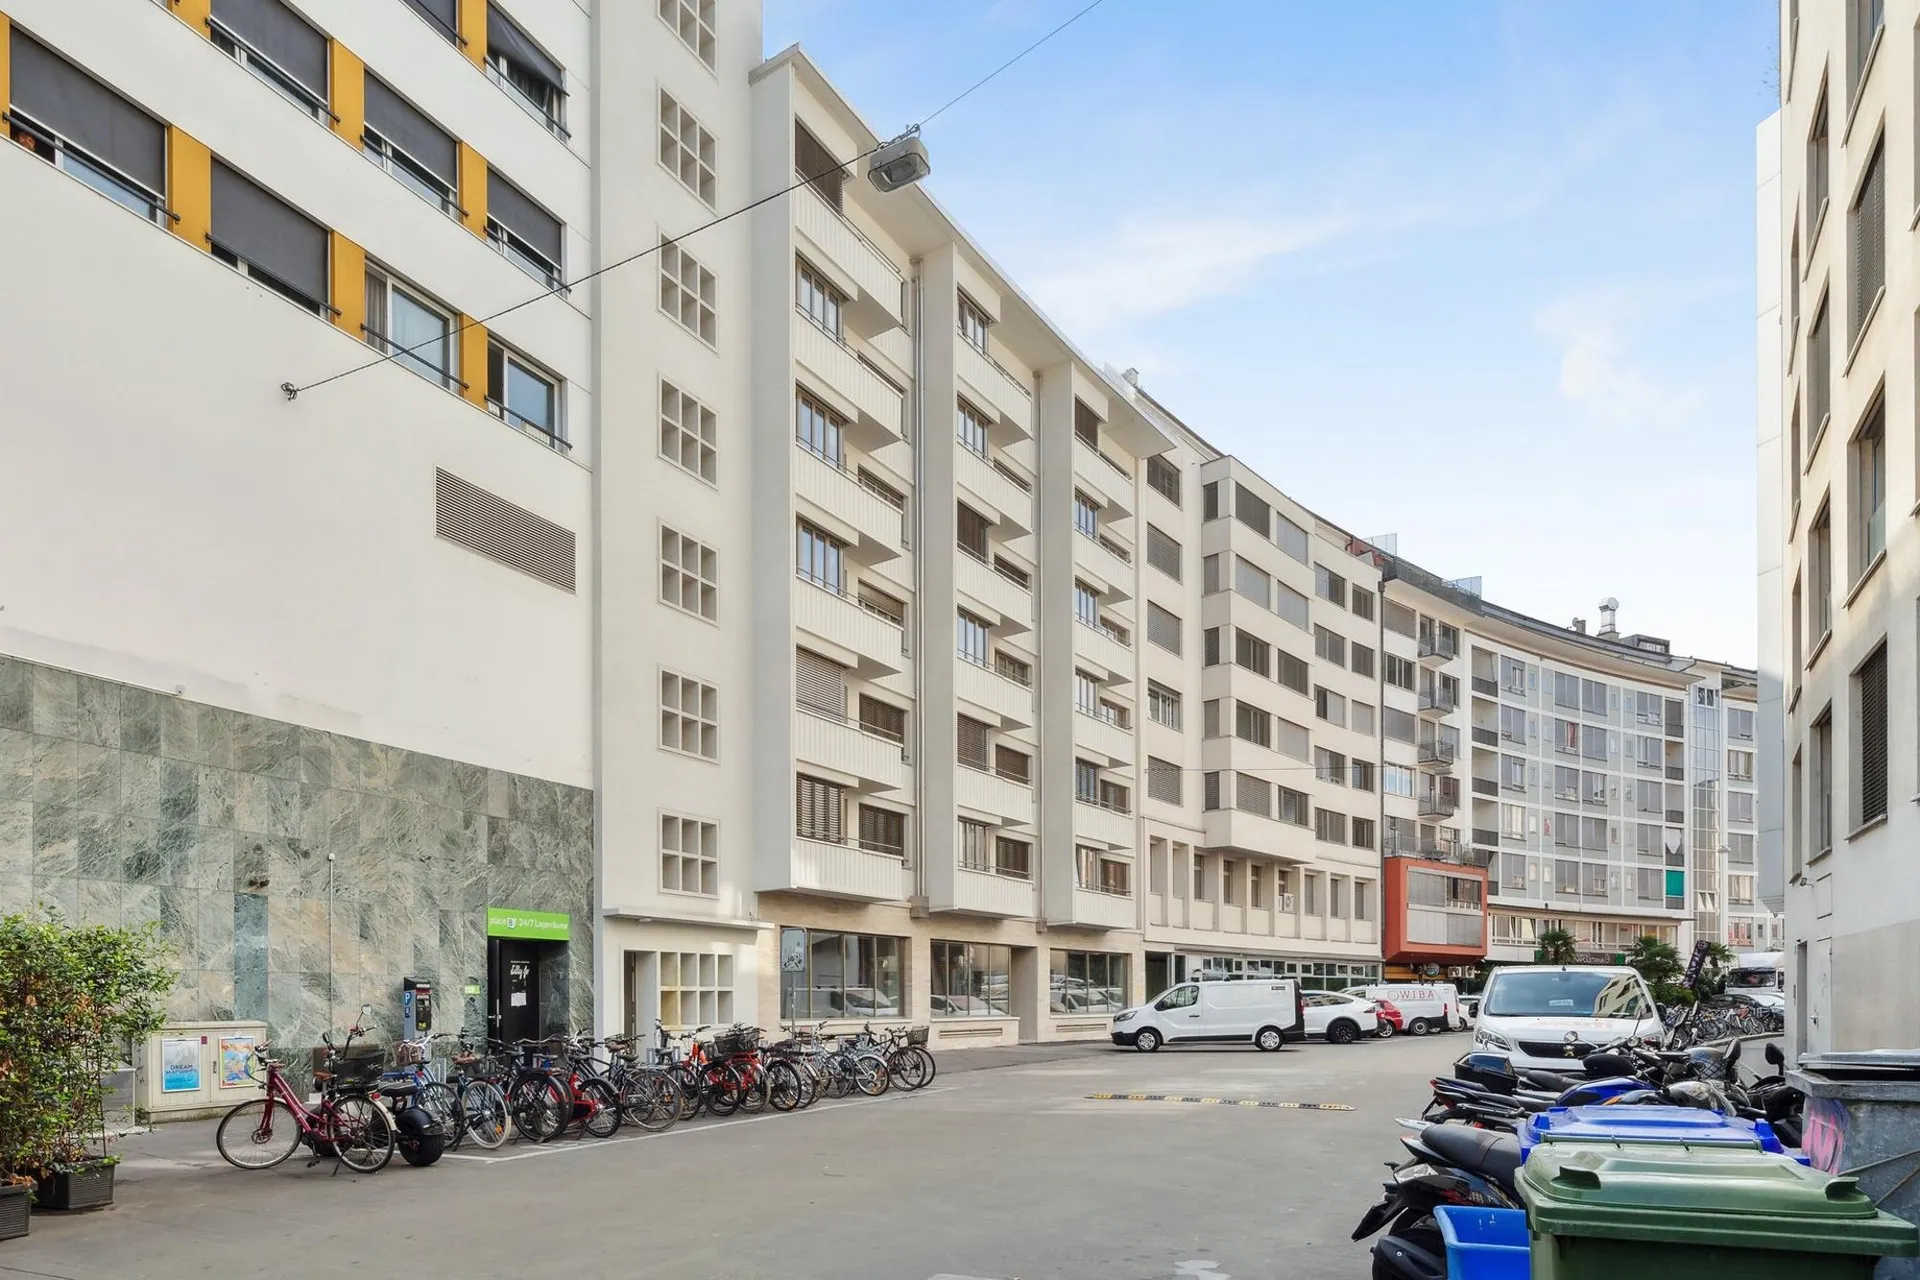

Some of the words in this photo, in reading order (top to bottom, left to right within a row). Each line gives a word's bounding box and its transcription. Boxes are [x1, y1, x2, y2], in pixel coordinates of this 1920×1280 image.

[519, 917, 535, 928] 24/7
[404, 992, 411, 1004] P
[1400, 990, 1434, 999] WIBA
